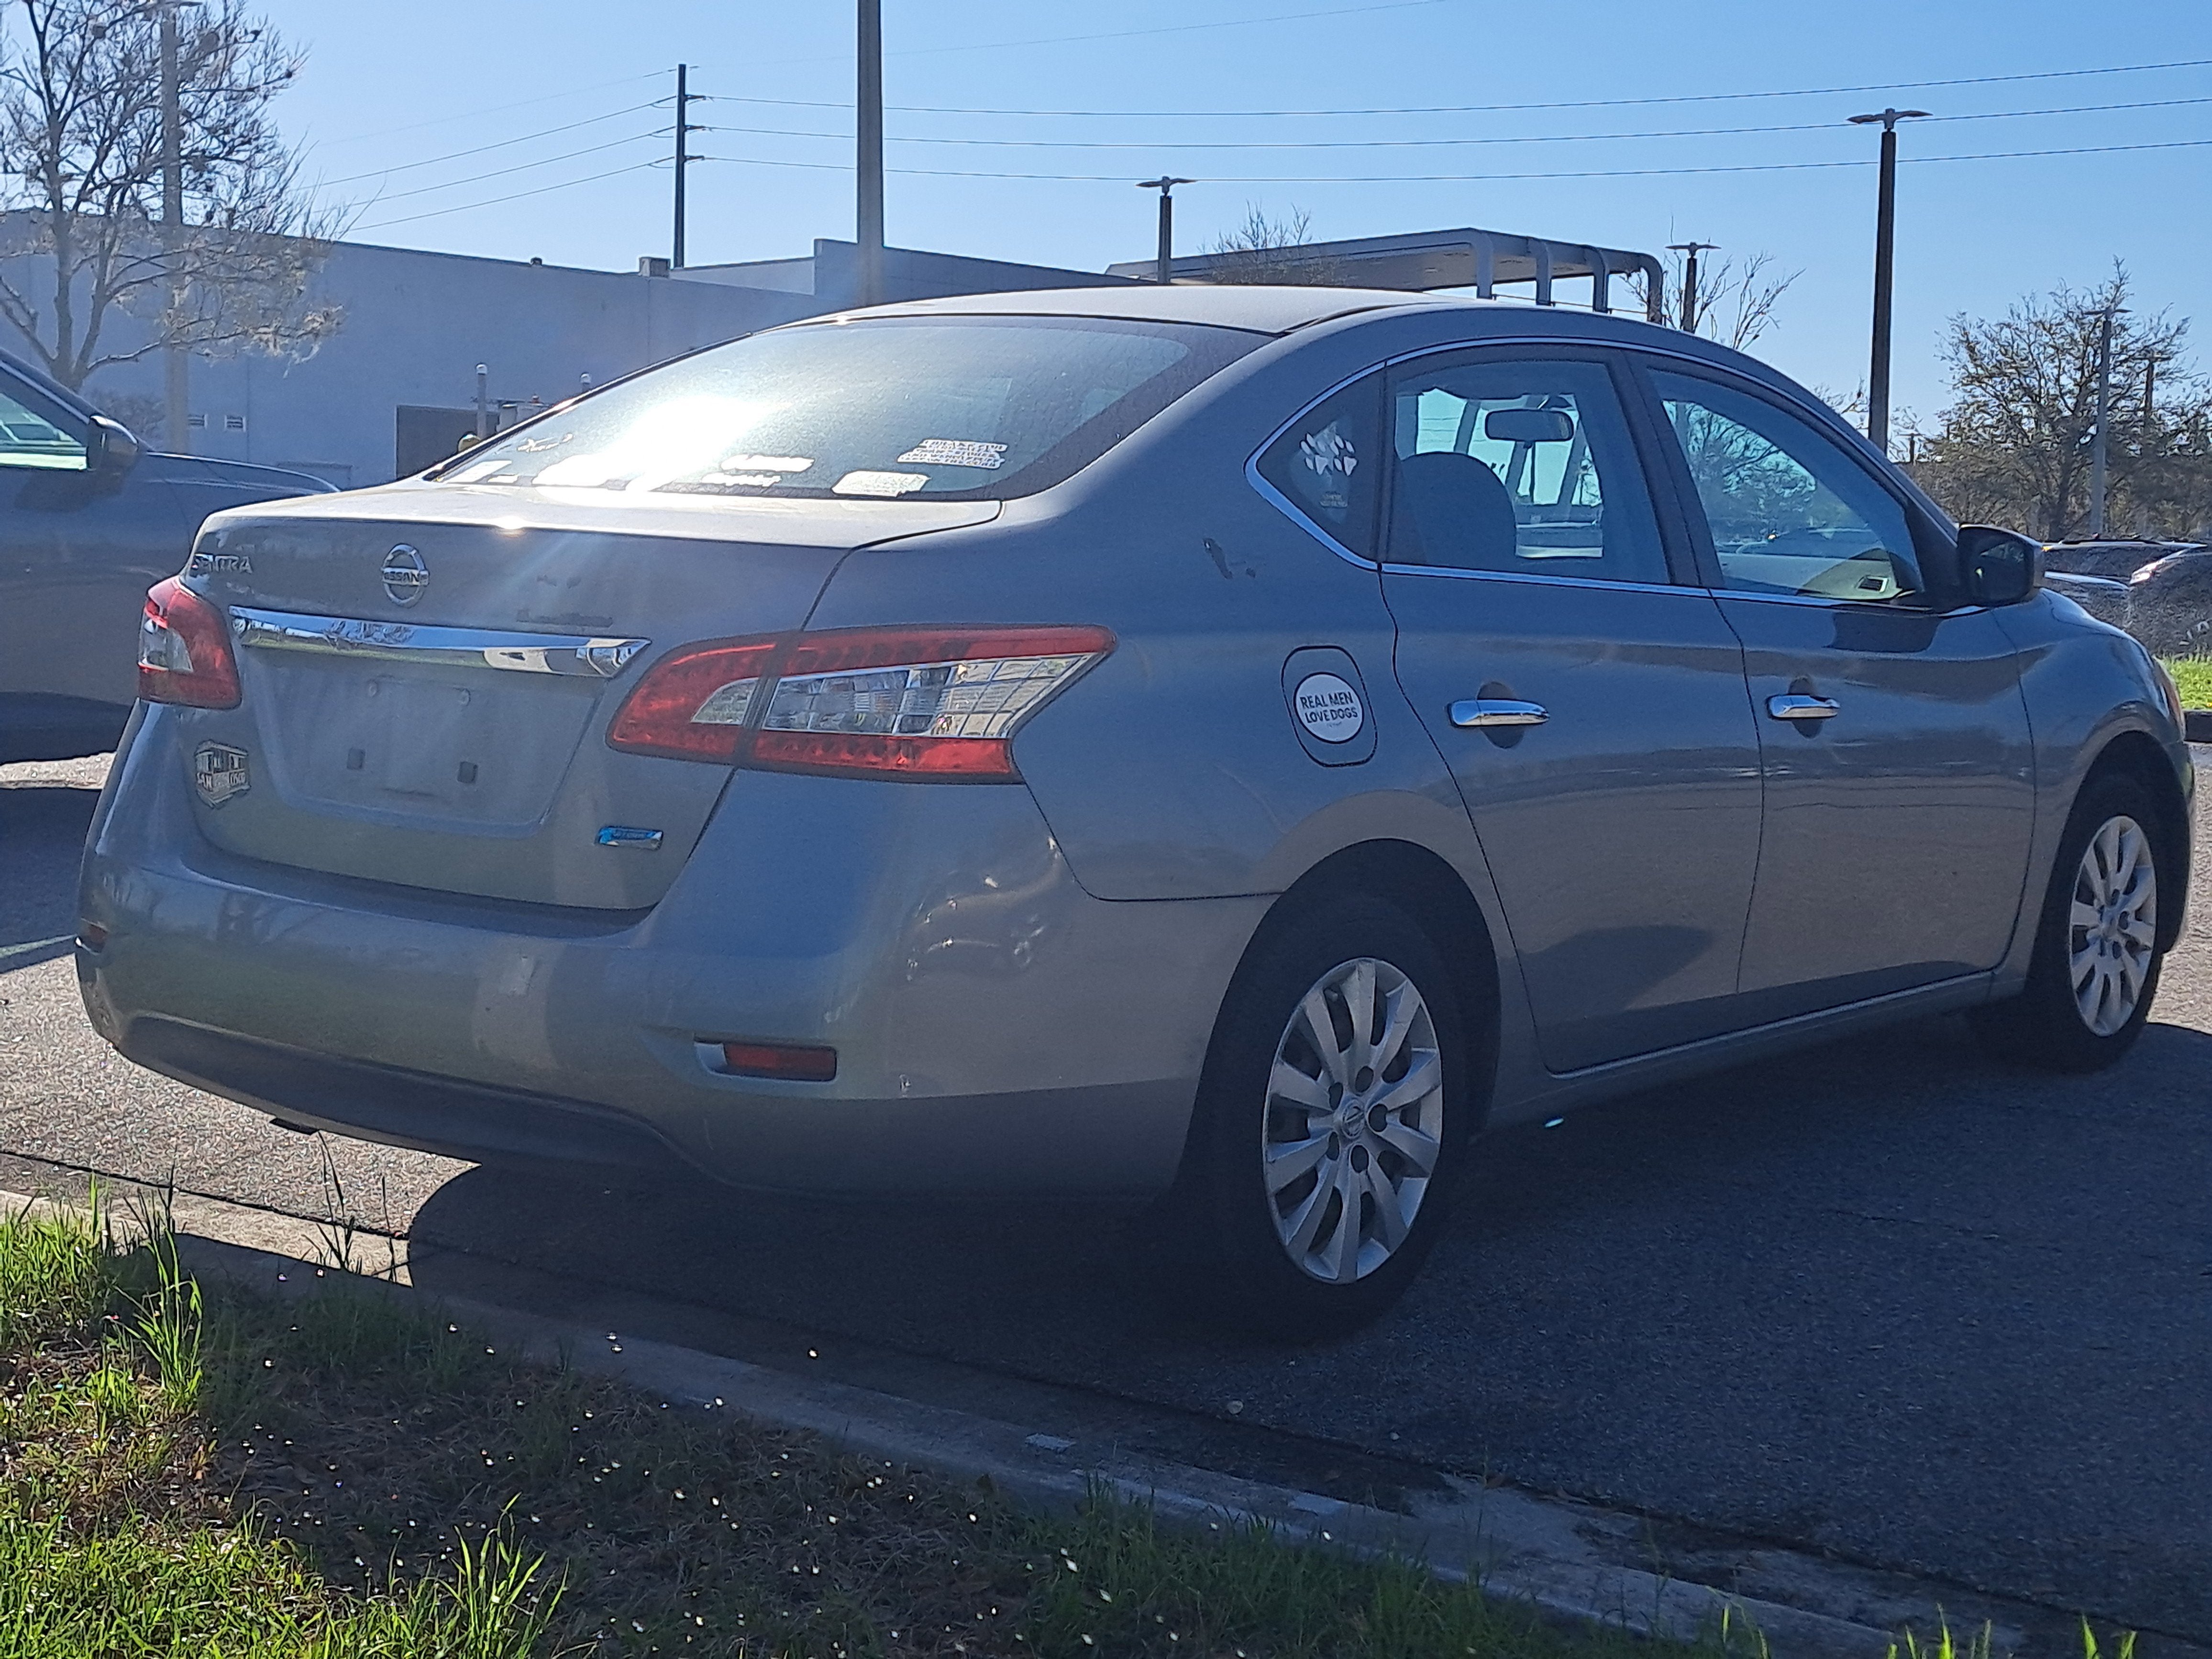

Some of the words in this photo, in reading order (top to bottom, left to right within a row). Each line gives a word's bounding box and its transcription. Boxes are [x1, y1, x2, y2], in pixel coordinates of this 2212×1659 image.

[1300, 695, 1328, 709] REAL
[1328, 691, 1353, 705] MEN
[1305, 710, 1330, 723] LOVE
[1330, 708, 1358, 720] DOGS
